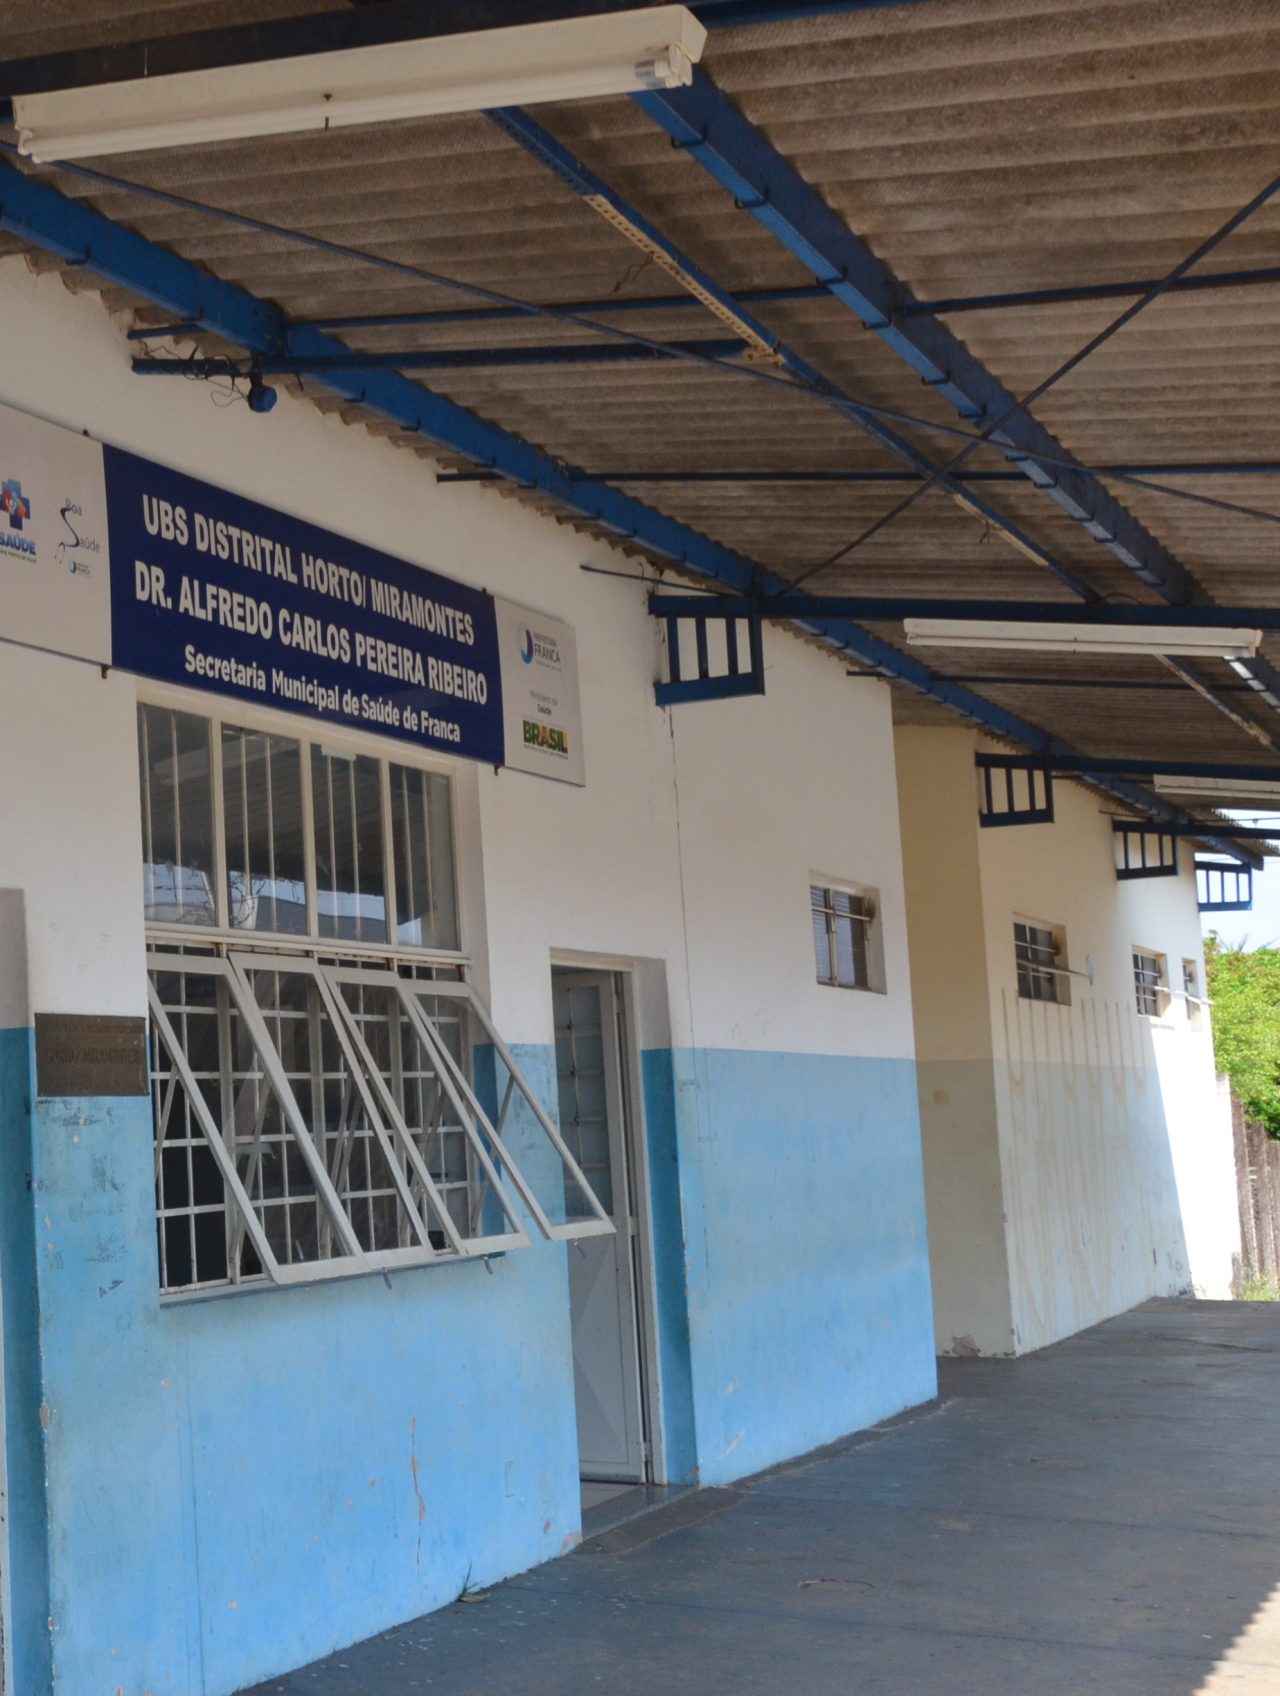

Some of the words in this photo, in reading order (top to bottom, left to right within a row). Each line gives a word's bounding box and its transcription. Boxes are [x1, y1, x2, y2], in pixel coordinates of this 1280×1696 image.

[143, 494, 189, 546] UBS
[194, 512, 298, 585] DISTRITAL
[371, 578, 474, 646] MIRAMONTES
[135, 560, 172, 610] DR.
[179, 575, 273, 640] ALFREDO
[278, 608, 351, 664] CARLOS
[355, 632, 426, 687] PEREIRA
[428, 656, 488, 705] RIBEIRO
[534, 643, 561, 665] FRANCA
[185, 645, 266, 692] Secretaria
[272, 668, 340, 712] Municipal
[343, 689, 360, 717] de
[361, 694, 400, 727] Saúde
[403, 711, 418, 732] de
[421, 710, 461, 743] Franca
[523, 720, 568, 754] BRASIL
